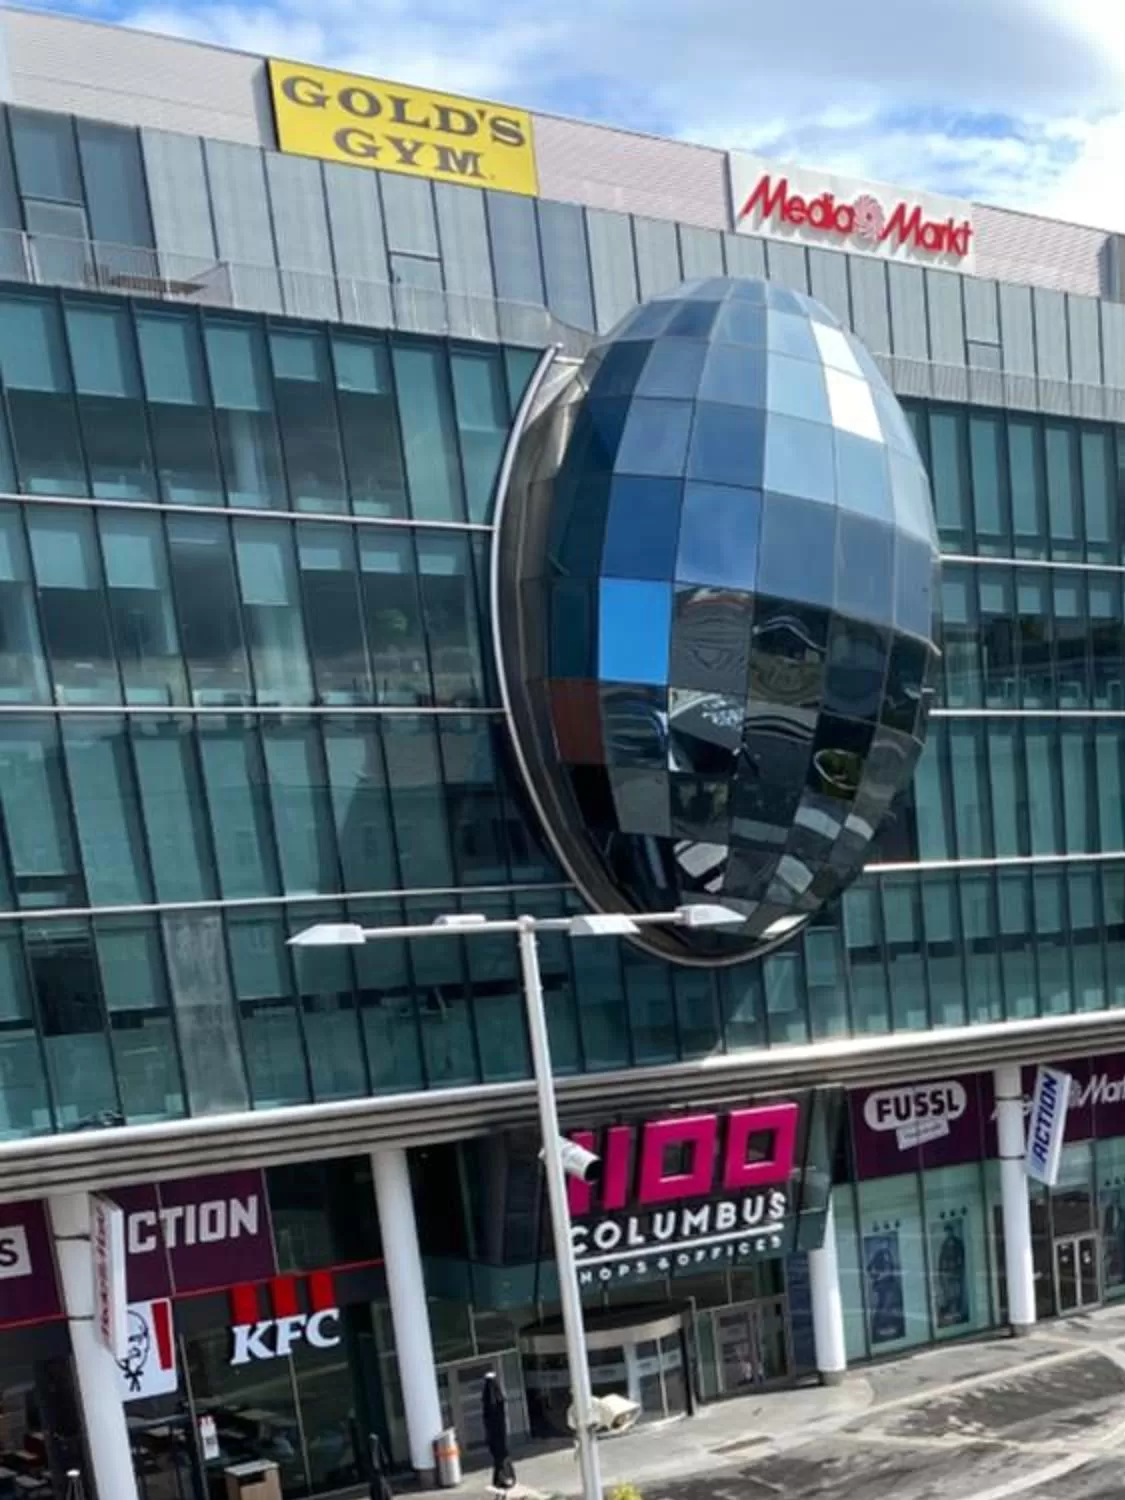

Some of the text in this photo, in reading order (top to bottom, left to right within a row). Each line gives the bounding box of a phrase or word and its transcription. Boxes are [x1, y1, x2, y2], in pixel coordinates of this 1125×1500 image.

[281, 75, 526, 147] GOLD'S
[333, 127, 488, 180] GYM
[876, 1088, 959, 1122] FUSSL
[1031, 1073, 1059, 1166] ACTION
[127, 1195, 258, 1255] CTION
[570, 1191, 787, 1253] COLUMBUS
[578, 1260, 648, 1285] HOPS
[677, 1235, 783, 1266] OFFICES
[230, 1308, 340, 1366] KFC
